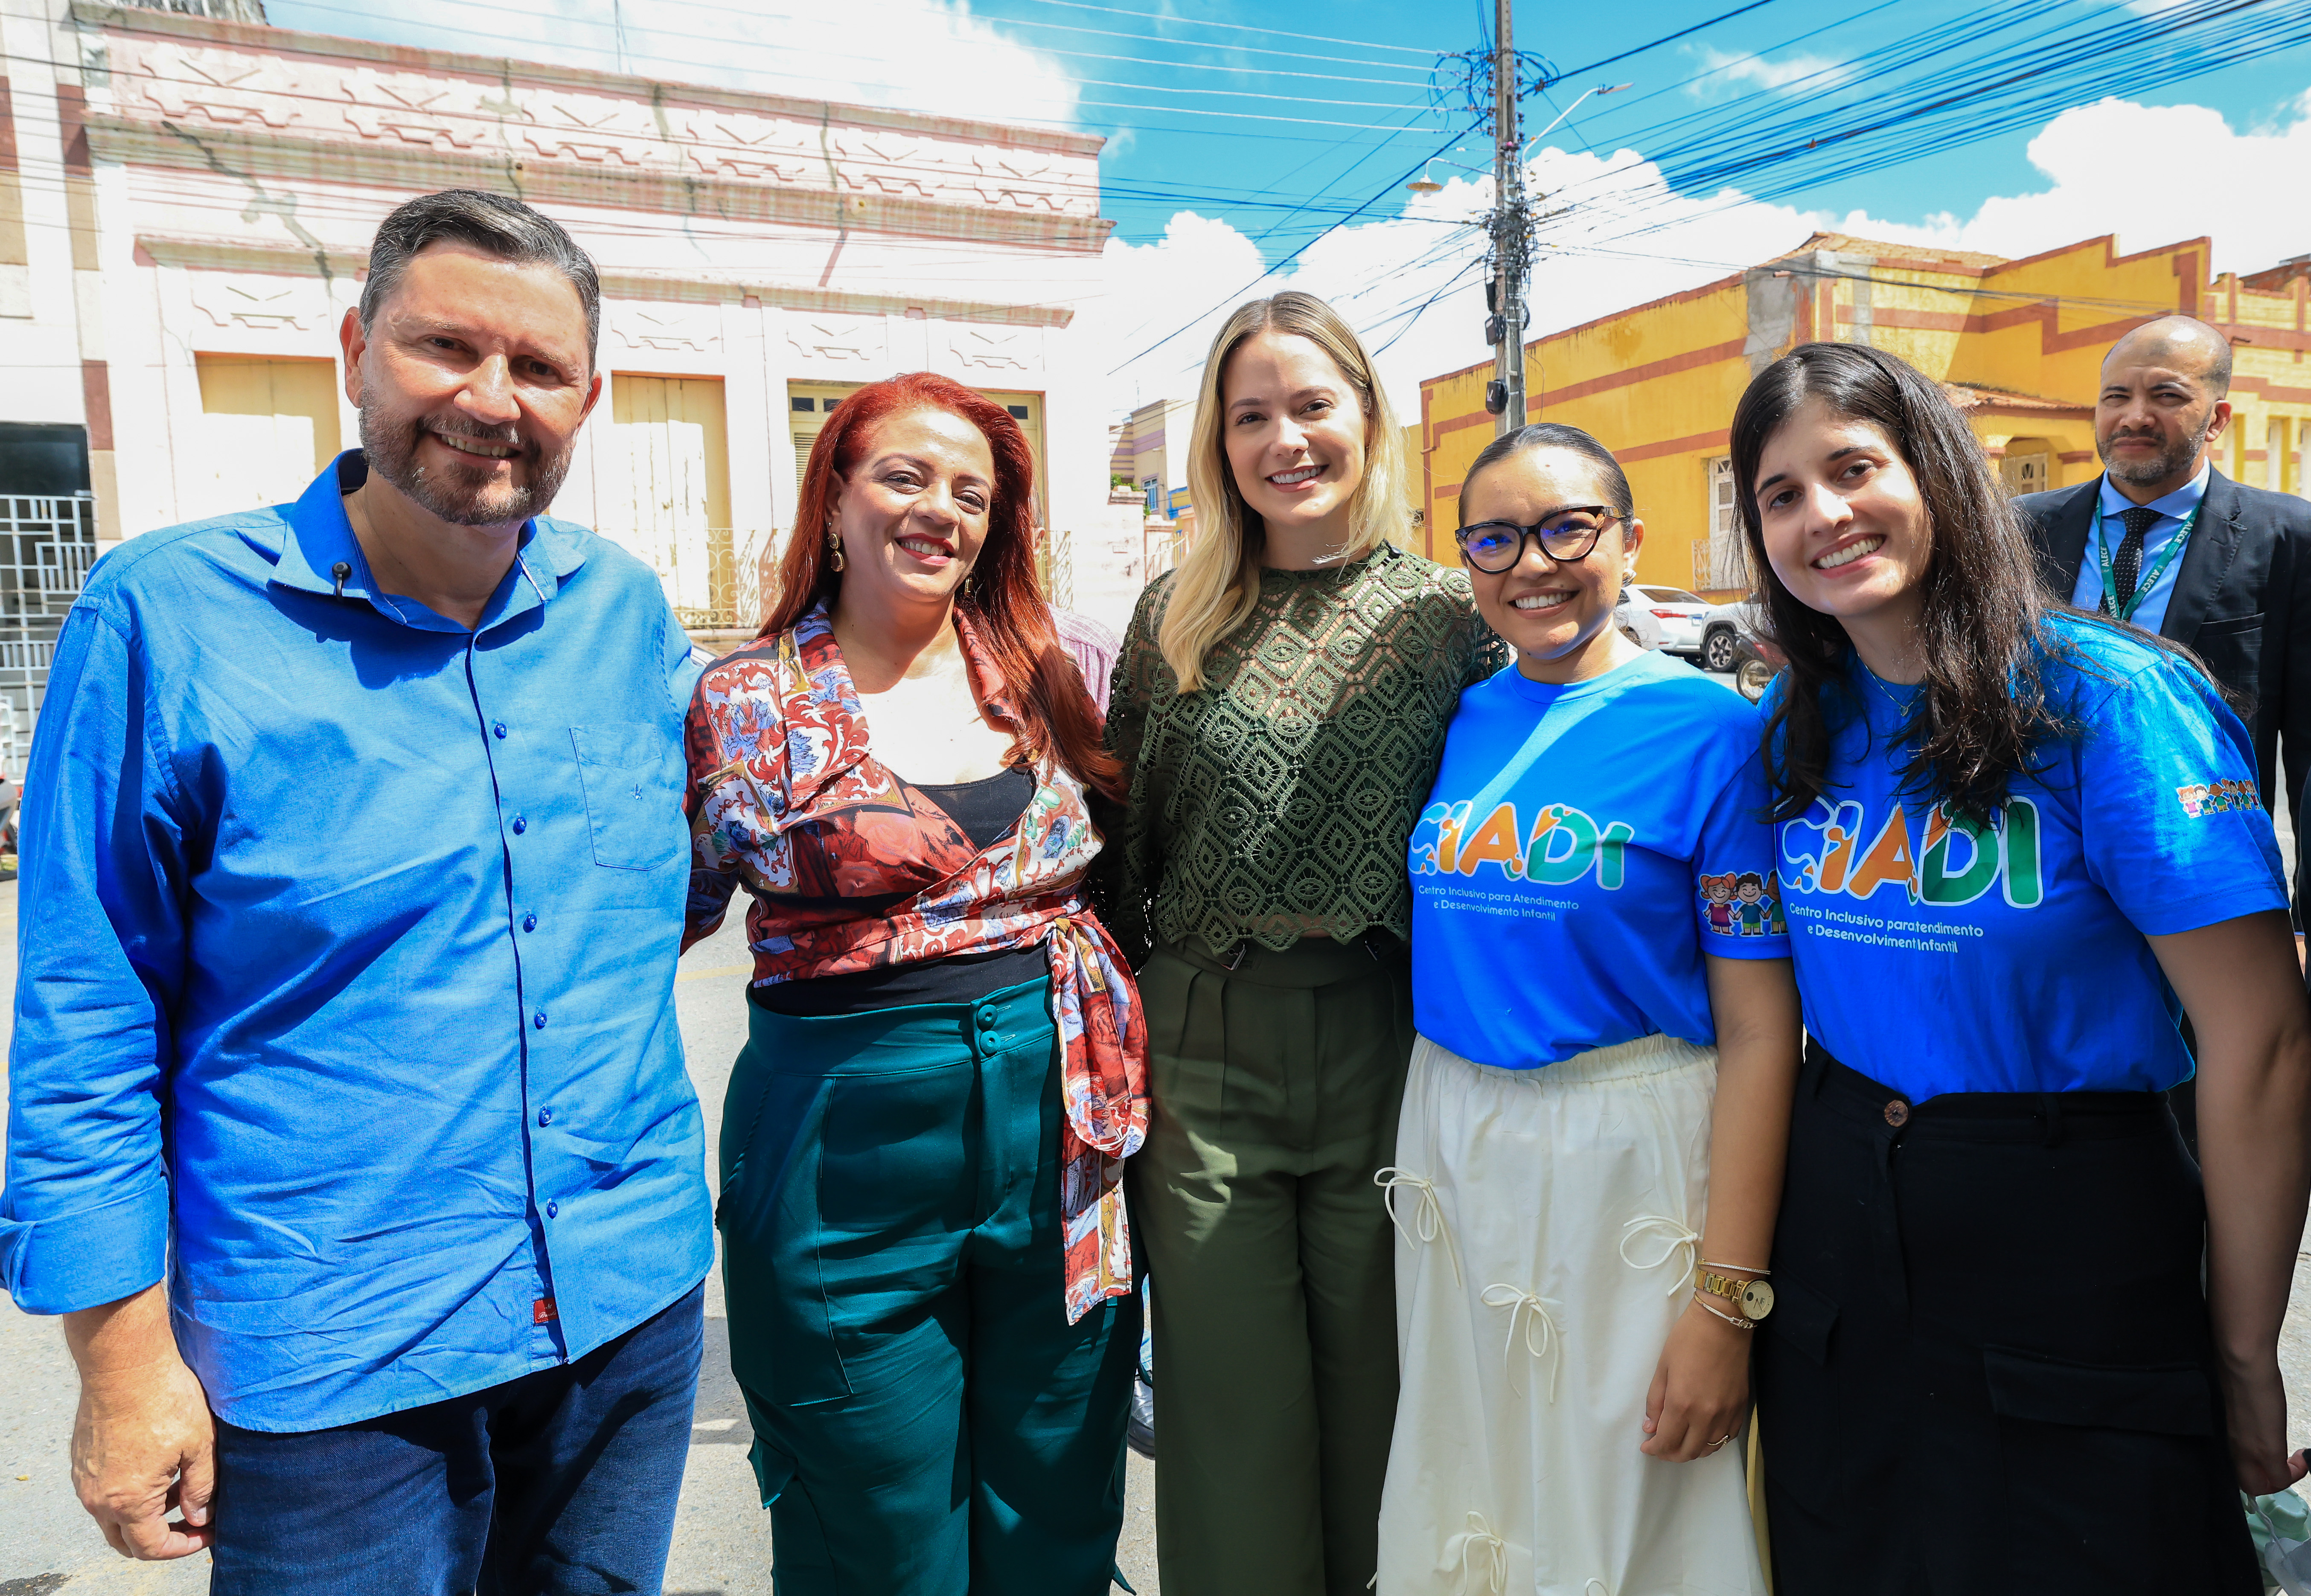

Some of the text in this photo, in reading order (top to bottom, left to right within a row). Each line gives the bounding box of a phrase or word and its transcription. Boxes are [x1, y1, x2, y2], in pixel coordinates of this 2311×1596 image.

[2174, 520, 2194, 544] ALECE
[2100, 546, 2110, 567] ALECE
[2141, 569, 2160, 593] ALECE
[2107, 595, 2119, 618] ALECE
[1418, 885, 1579, 910] Centro Inclusivo para Atendimento
[1441, 899, 1519, 917] Desenvolvimento
[1522, 907, 1556, 922] Infantil
[1790, 902, 1984, 938] Centro Inclusivo para tendimento
[1807, 924, 1959, 954] e Desenvolviment Infantil
